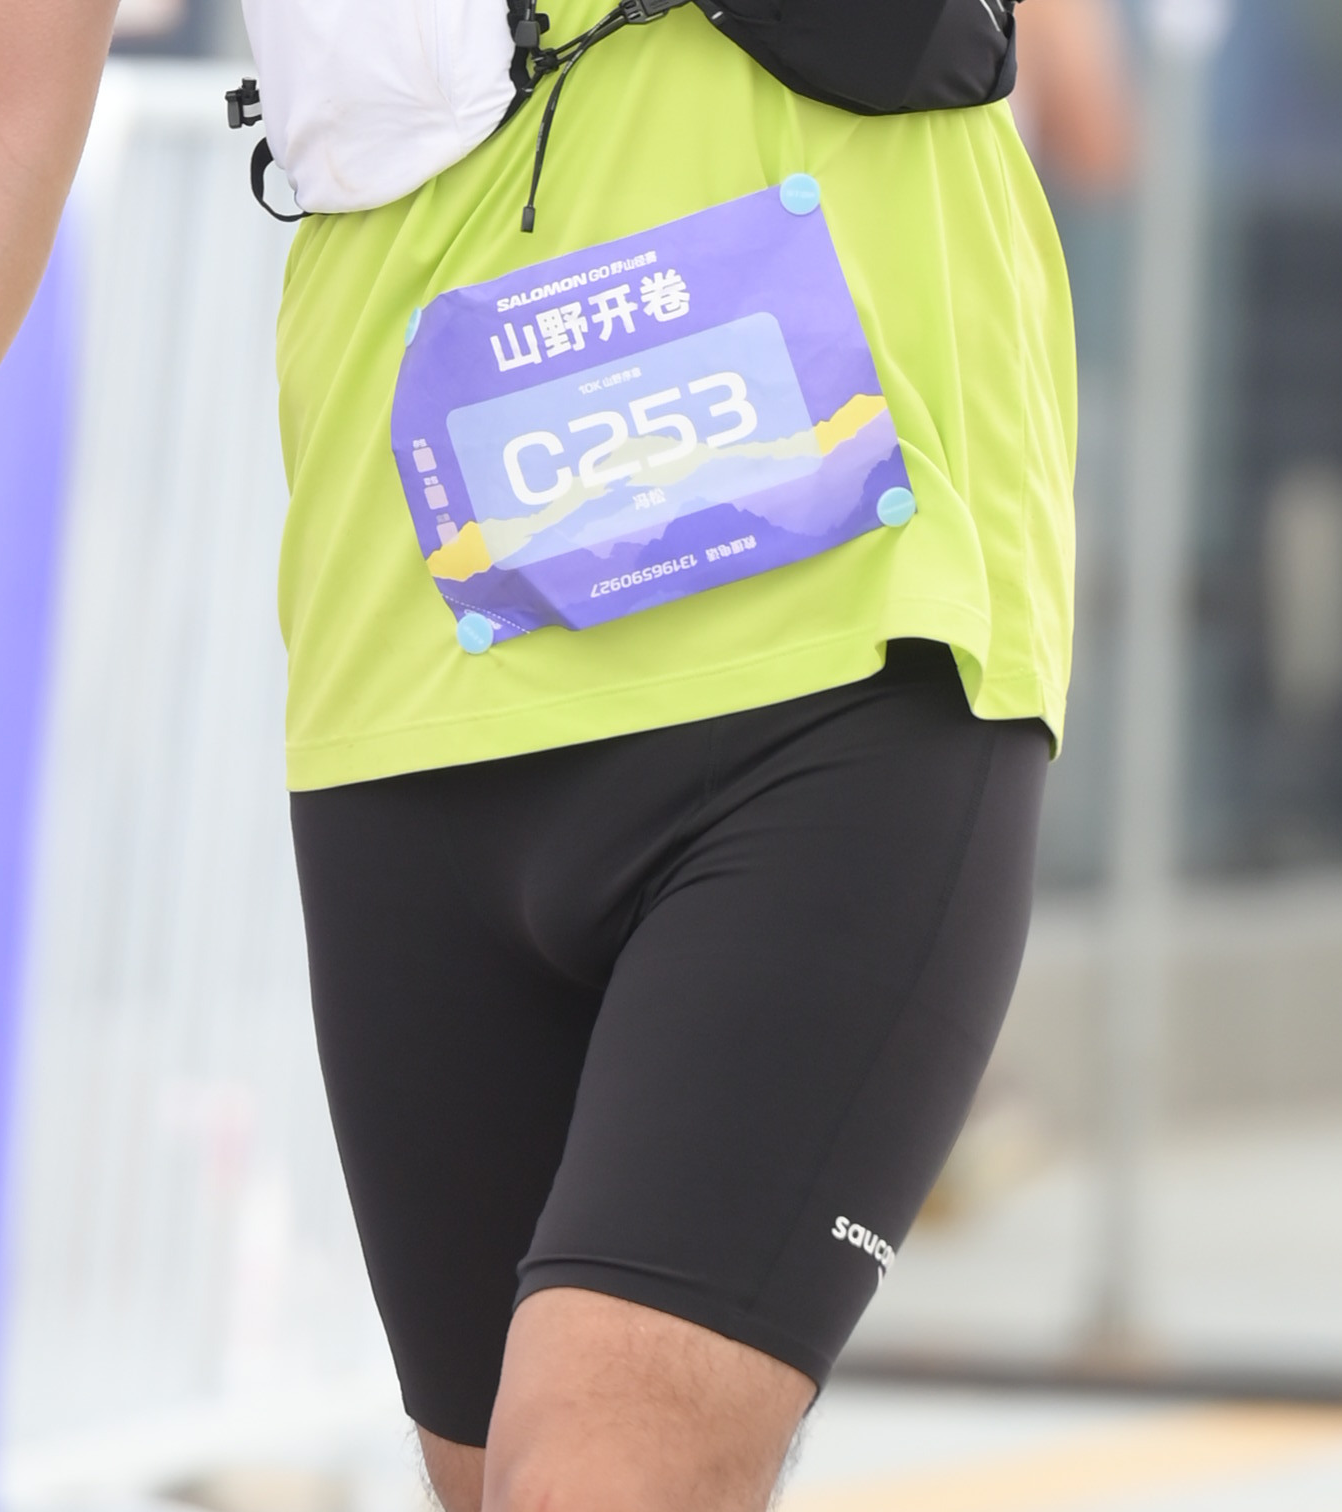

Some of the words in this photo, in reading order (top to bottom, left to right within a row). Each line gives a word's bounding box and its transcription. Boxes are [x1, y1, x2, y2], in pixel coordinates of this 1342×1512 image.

[490, 268, 691, 372] 山野开卷
[496, 271, 587, 313] SALOMON
[502, 371, 759, 506] C253
[831, 1215, 895, 1268] sauco
